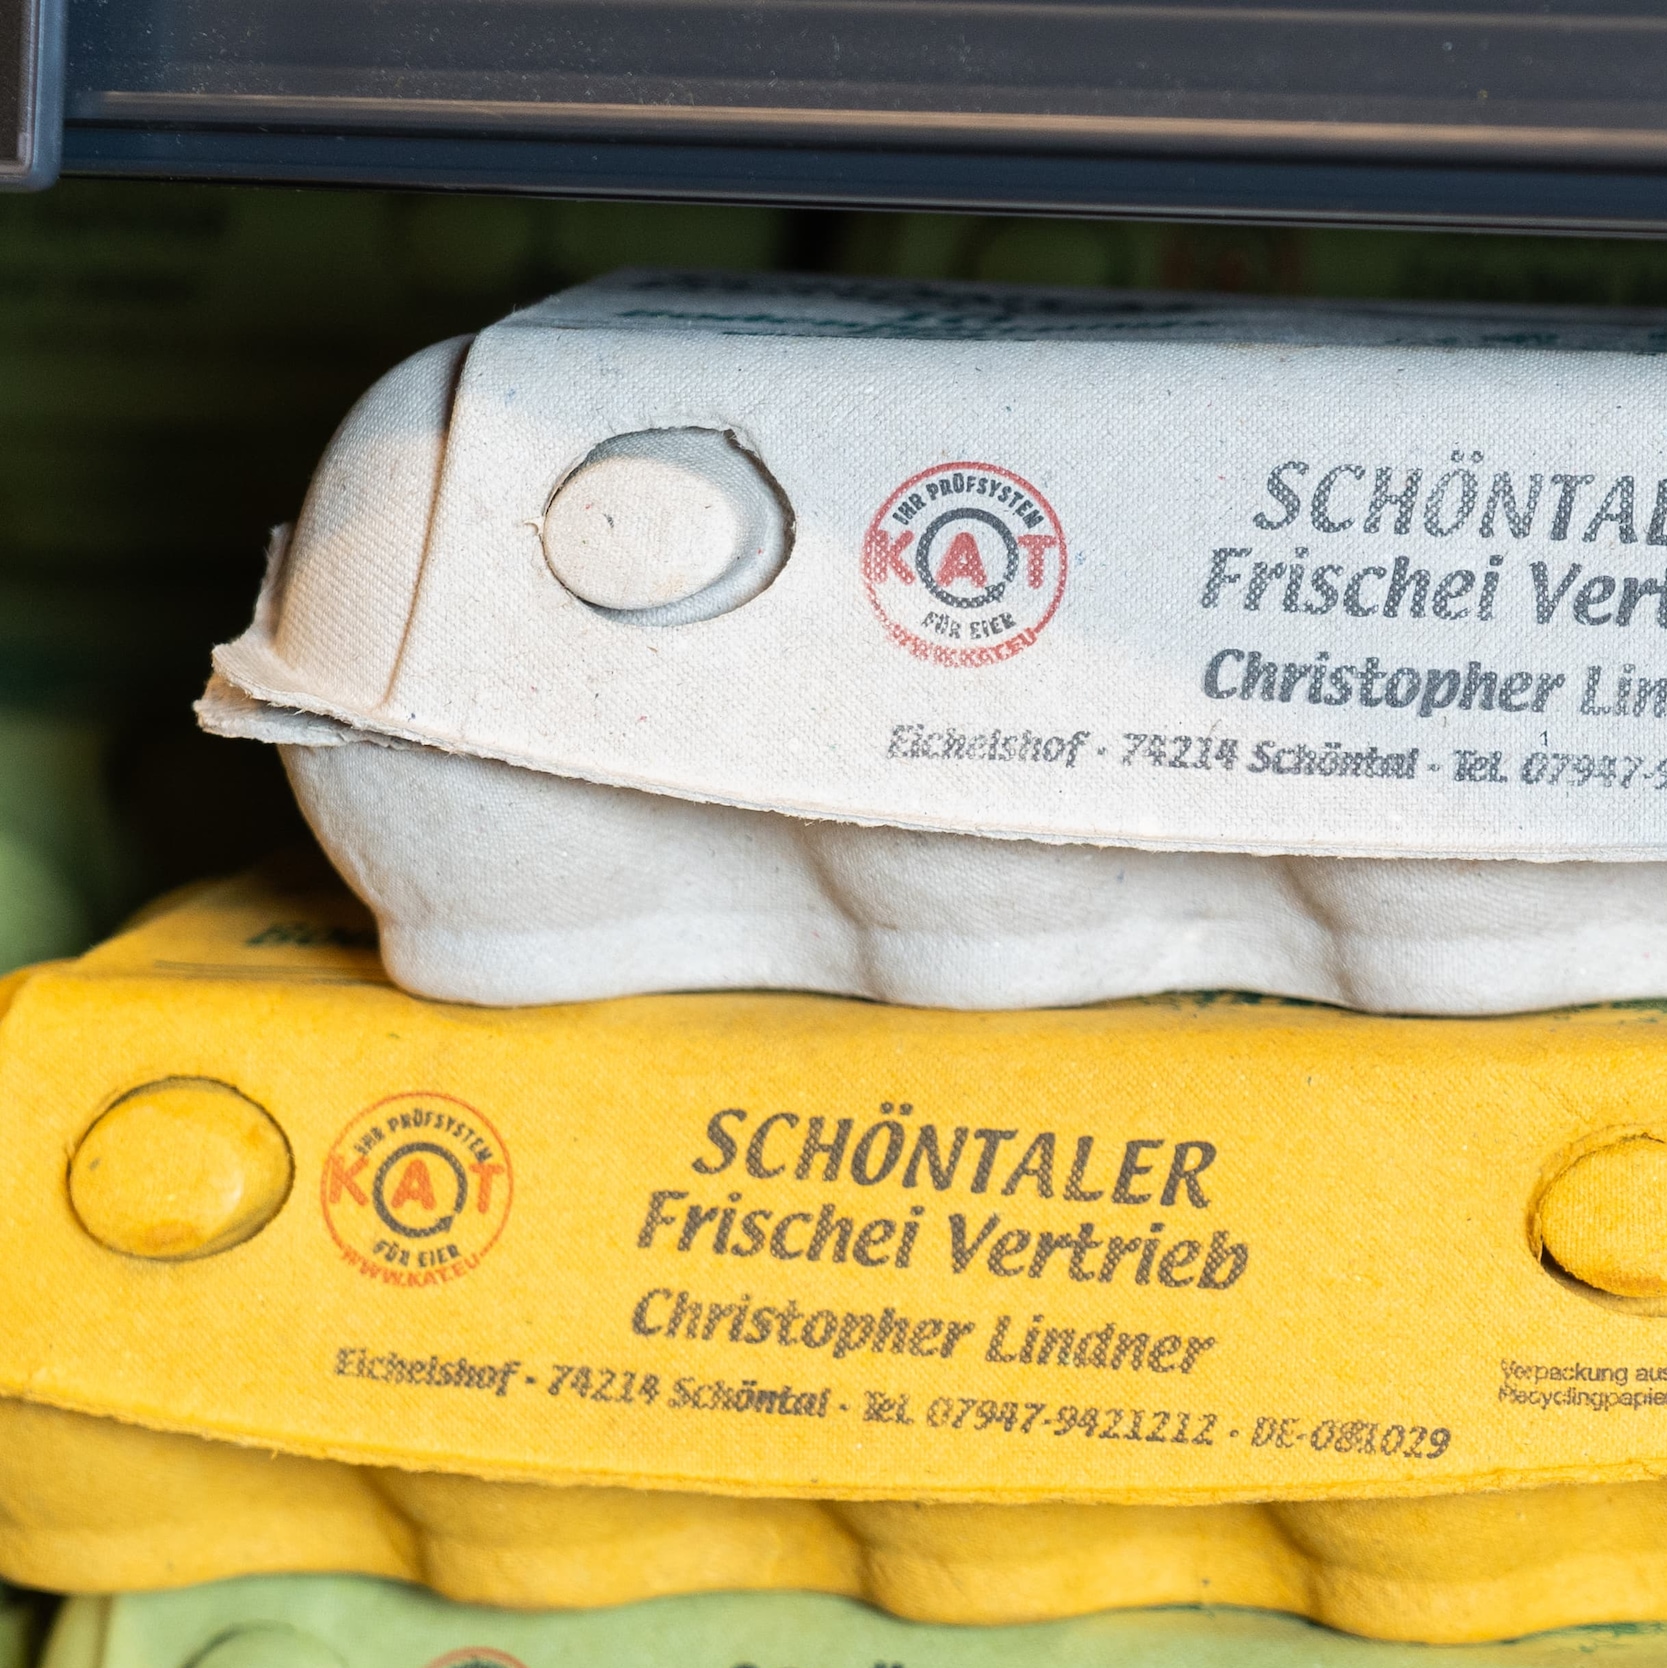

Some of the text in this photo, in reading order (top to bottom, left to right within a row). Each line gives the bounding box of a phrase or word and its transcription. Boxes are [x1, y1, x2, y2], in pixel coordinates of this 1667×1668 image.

[860, 530, 1058, 590] KAT
[1199, 546, 1502, 623] Frischei
[1202, 647, 1566, 718] Christopher
[886, 724, 1092, 768] Eichelshof
[1121, 732, 1238, 771] 74214
[1247, 740, 1419, 781] Schöntal
[328, 1154, 505, 1214] KAT
[692, 1102, 1218, 1210] SCHÖNTALER
[636, 1188, 1250, 1293] Frischei Vertrieb
[630, 1285, 1217, 1376] Christopher Lindner
[333, 1346, 517, 1398] Eichelshof
[547, 1362, 662, 1407] 74214
[669, 1374, 831, 1423] Schöntal
[927, 1395, 1217, 1446] 07947-9421212
[1250, 1414, 1452, 1462] DE-081029
[1501, 1358, 1628, 1386] Verpackung
